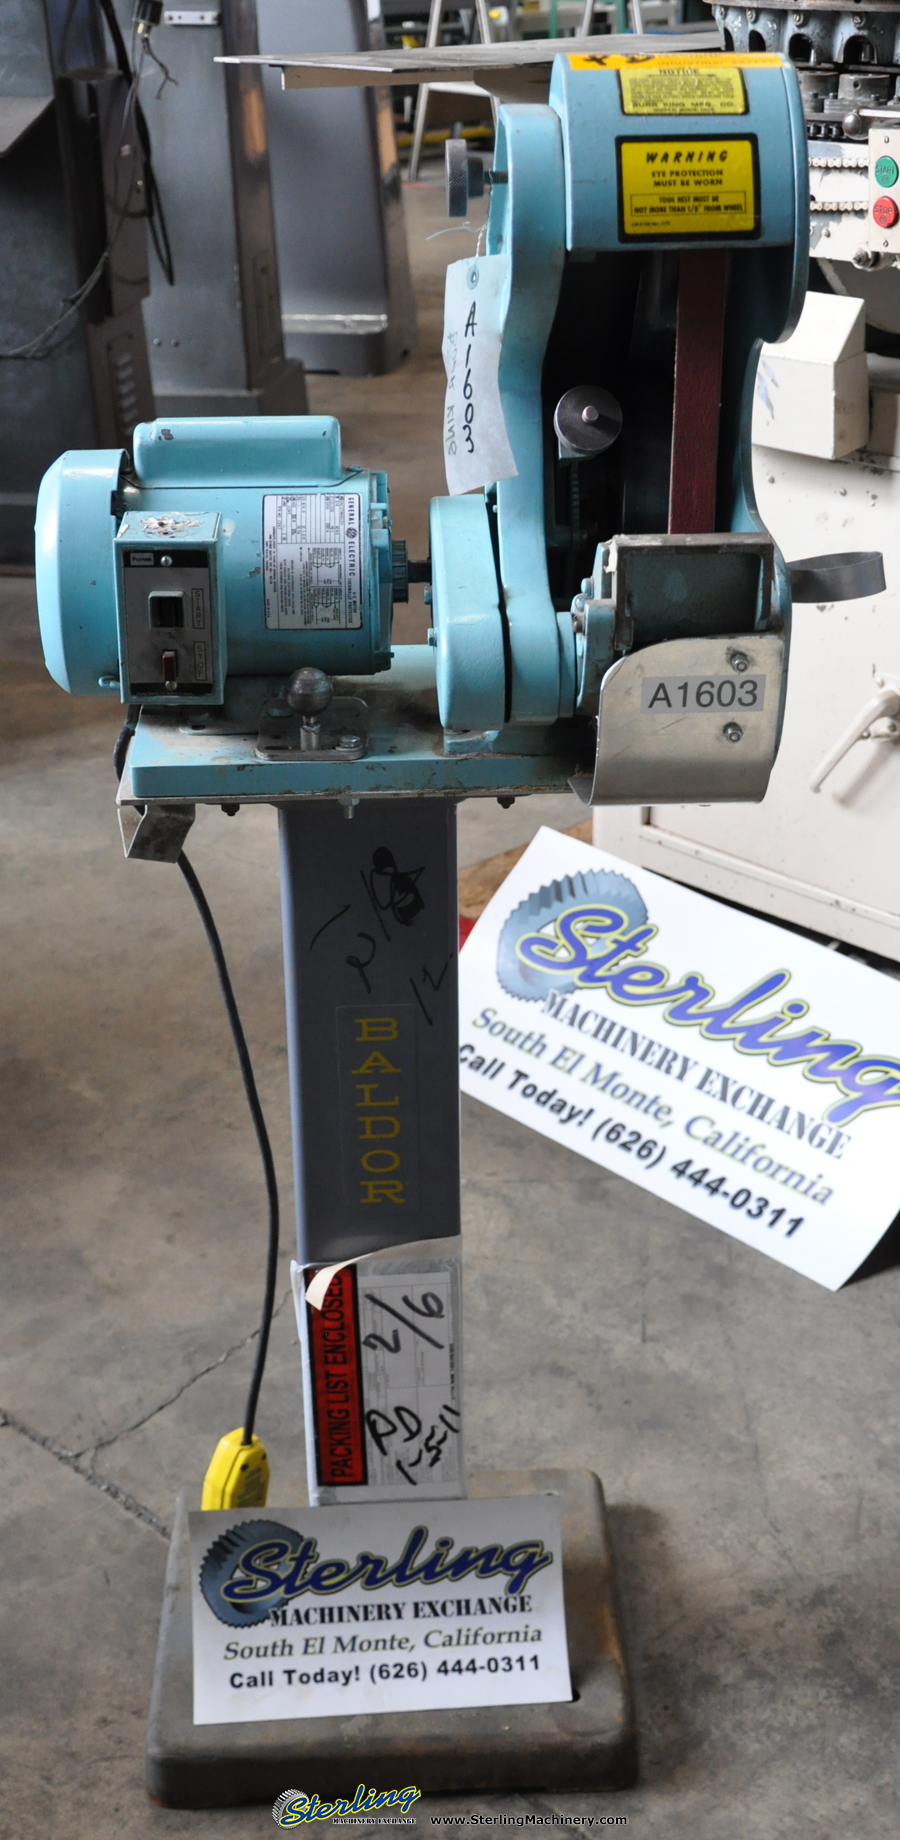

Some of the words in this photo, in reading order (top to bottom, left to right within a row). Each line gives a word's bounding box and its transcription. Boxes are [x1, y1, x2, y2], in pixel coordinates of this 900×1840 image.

[646, 150, 728, 164] WARNING
[670, 169, 723, 178] PROTECTION
[876, 165, 895, 175] START
[653, 179, 677, 187] MUST
[680, 179, 690, 187] BE
[694, 178, 723, 186] WORN
[659, 196, 675, 204] TOOL
[693, 195, 709, 203] MUST
[634, 206, 647, 214] NOT
[668, 205, 686, 213] THAN
[704, 204, 722, 212] FROM
[724, 203, 743, 212] WHEEL
[874, 205, 892, 215] STOP
[463, 300, 478, 453] A1603
[348, 497, 356, 525] GENERAL
[348, 541, 356, 577] ELECTRIC
[194, 590, 202, 628] START
[196, 645, 204, 678] STOP
[648, 680, 758, 708] A1603
[515, 903, 900, 1128] Sterling
[541, 989, 698, 1084] MACHINERY
[695, 1065, 852, 1160] EXCHANGE
[350, 1017, 406, 1204] BALDOR
[472, 1008, 550, 1061] South
[550, 1045, 583, 1075] El
[579, 1060, 677, 1130] Monte,
[683, 1112, 834, 1206] California
[459, 1043, 506, 1081] Call
[507, 1069, 595, 1127] Today!
[591, 1117, 669, 1170] (626)
[669, 1158, 806, 1239] 444-0311
[321, 1276, 347, 1367] ENCLOSED
[325, 1370, 350, 1405] LIST
[328, 1408, 354, 1479] PACKING
[220, 1524, 553, 1605] Sterling
[271, 1602, 407, 1628] MACHINERY
[413, 1594, 533, 1620] EXCHANGE
[223, 1638, 294, 1661] South
[302, 1636, 325, 1656] El
[332, 1632, 416, 1655] Monte,
[424, 1624, 543, 1649] California
[230, 1671, 274, 1689] Call
[283, 1666, 361, 1691] Today!
[369, 1662, 428, 1685] (626)
[436, 1654, 541, 1677] 444-0311
